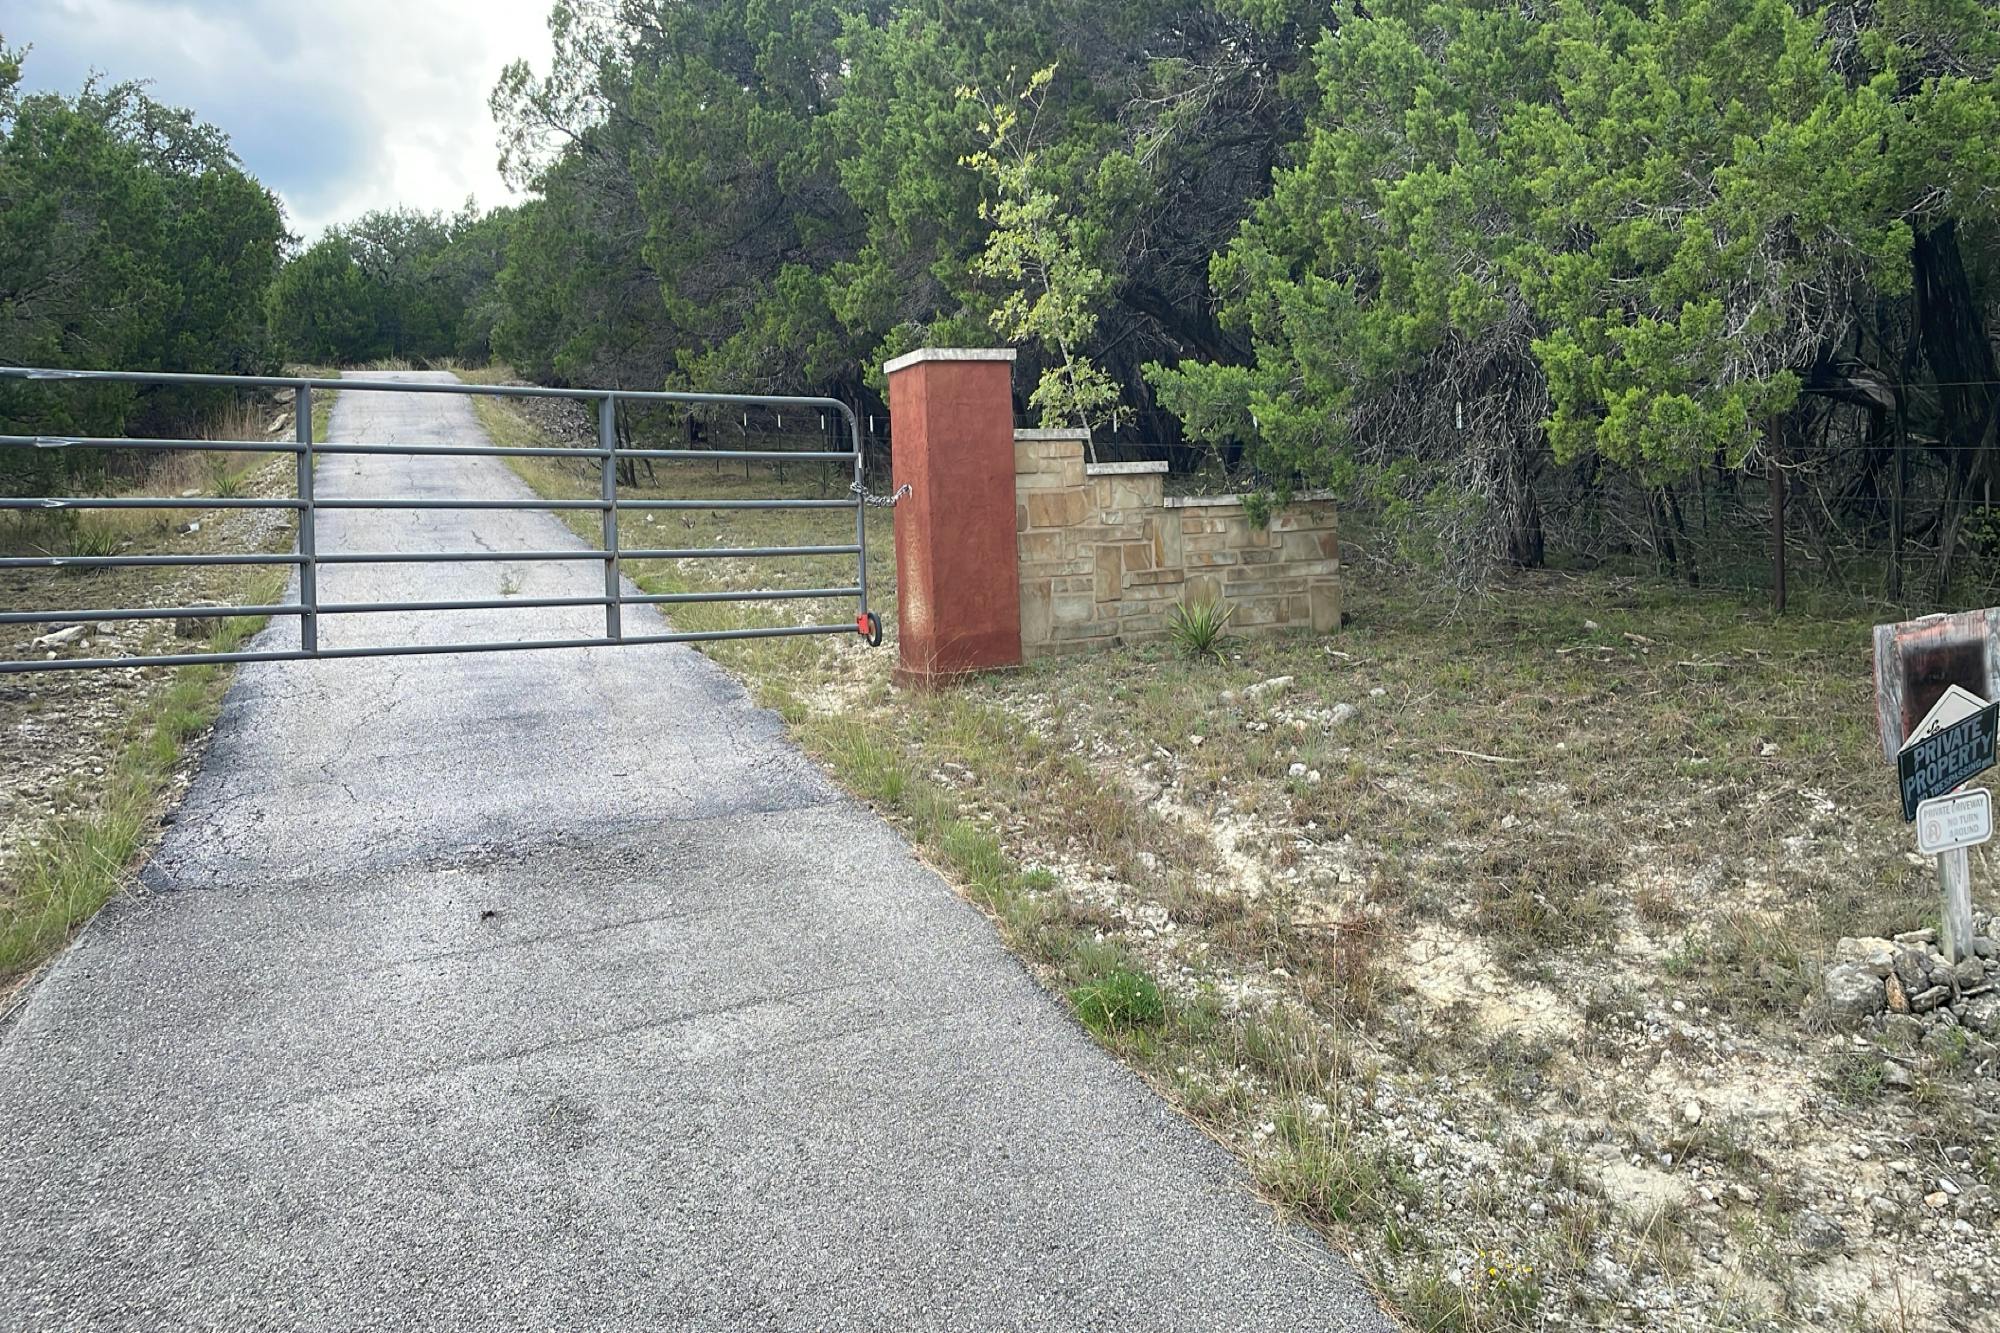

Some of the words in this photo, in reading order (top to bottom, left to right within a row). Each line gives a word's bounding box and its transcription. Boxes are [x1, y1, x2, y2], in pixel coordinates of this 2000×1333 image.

[1904, 731, 1993, 801] PROPERTY
[1914, 714, 1983, 771] PRIVATE
[1929, 758, 1982, 797] TRESPASSING
[1923, 805, 1950, 818] PRIVATE
